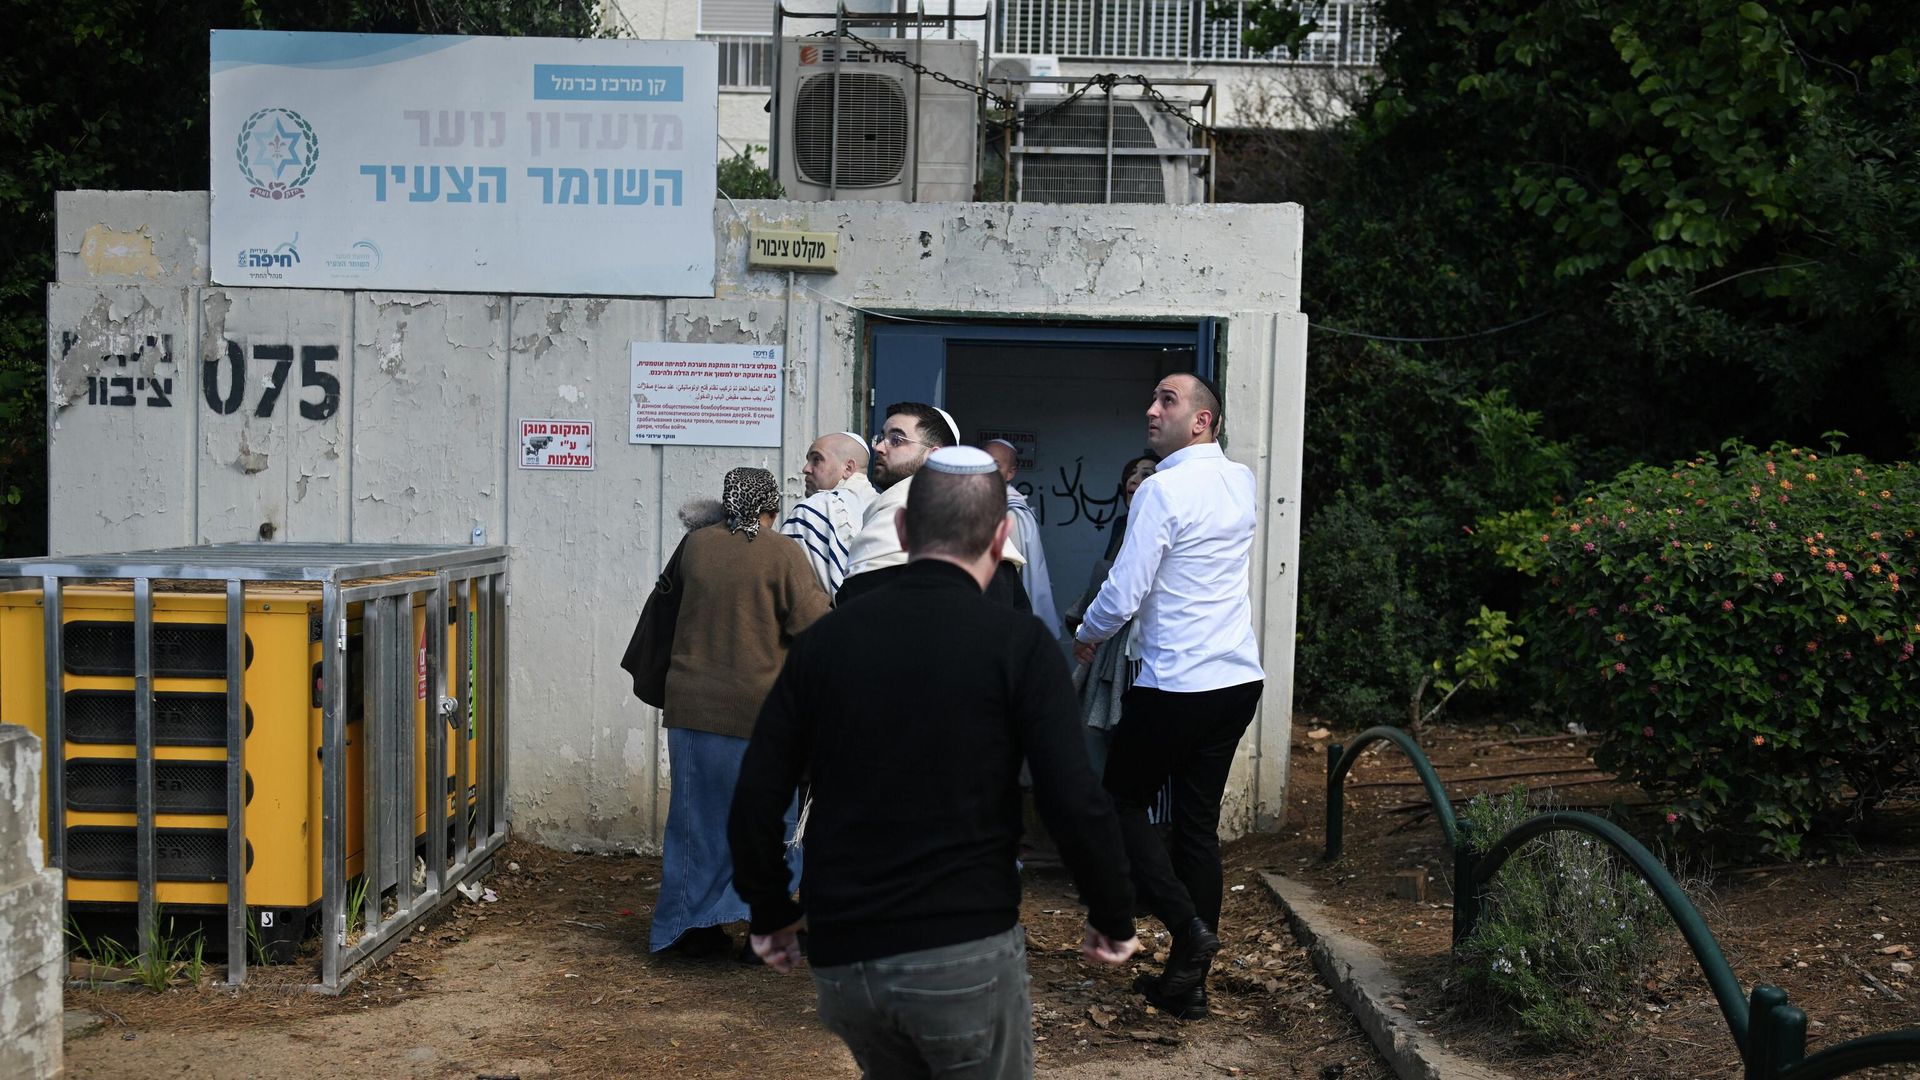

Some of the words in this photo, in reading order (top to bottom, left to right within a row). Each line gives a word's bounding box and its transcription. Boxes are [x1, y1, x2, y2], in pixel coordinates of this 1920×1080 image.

[551, 75, 596, 91] כרמל
[601, 77, 642, 92] מרכז
[648, 79, 666, 96] קן
[404, 110, 506, 148] נוער
[527, 112, 683, 156] מועדון
[360, 165, 507, 204] הצעיר
[527, 167, 683, 206] השומר
[757, 239, 790, 257] ציבורי
[793, 236, 826, 263] מקלט
[249, 254, 292, 267] חיפה
[757, 363, 777, 371] במקלט
[203, 340, 340, 421] 075
[524, 423, 547, 436] מוגן
[550, 424, 590, 437] המקום
[560, 440, 577, 450] ע"י
[547, 452, 590, 466] מצלמות
